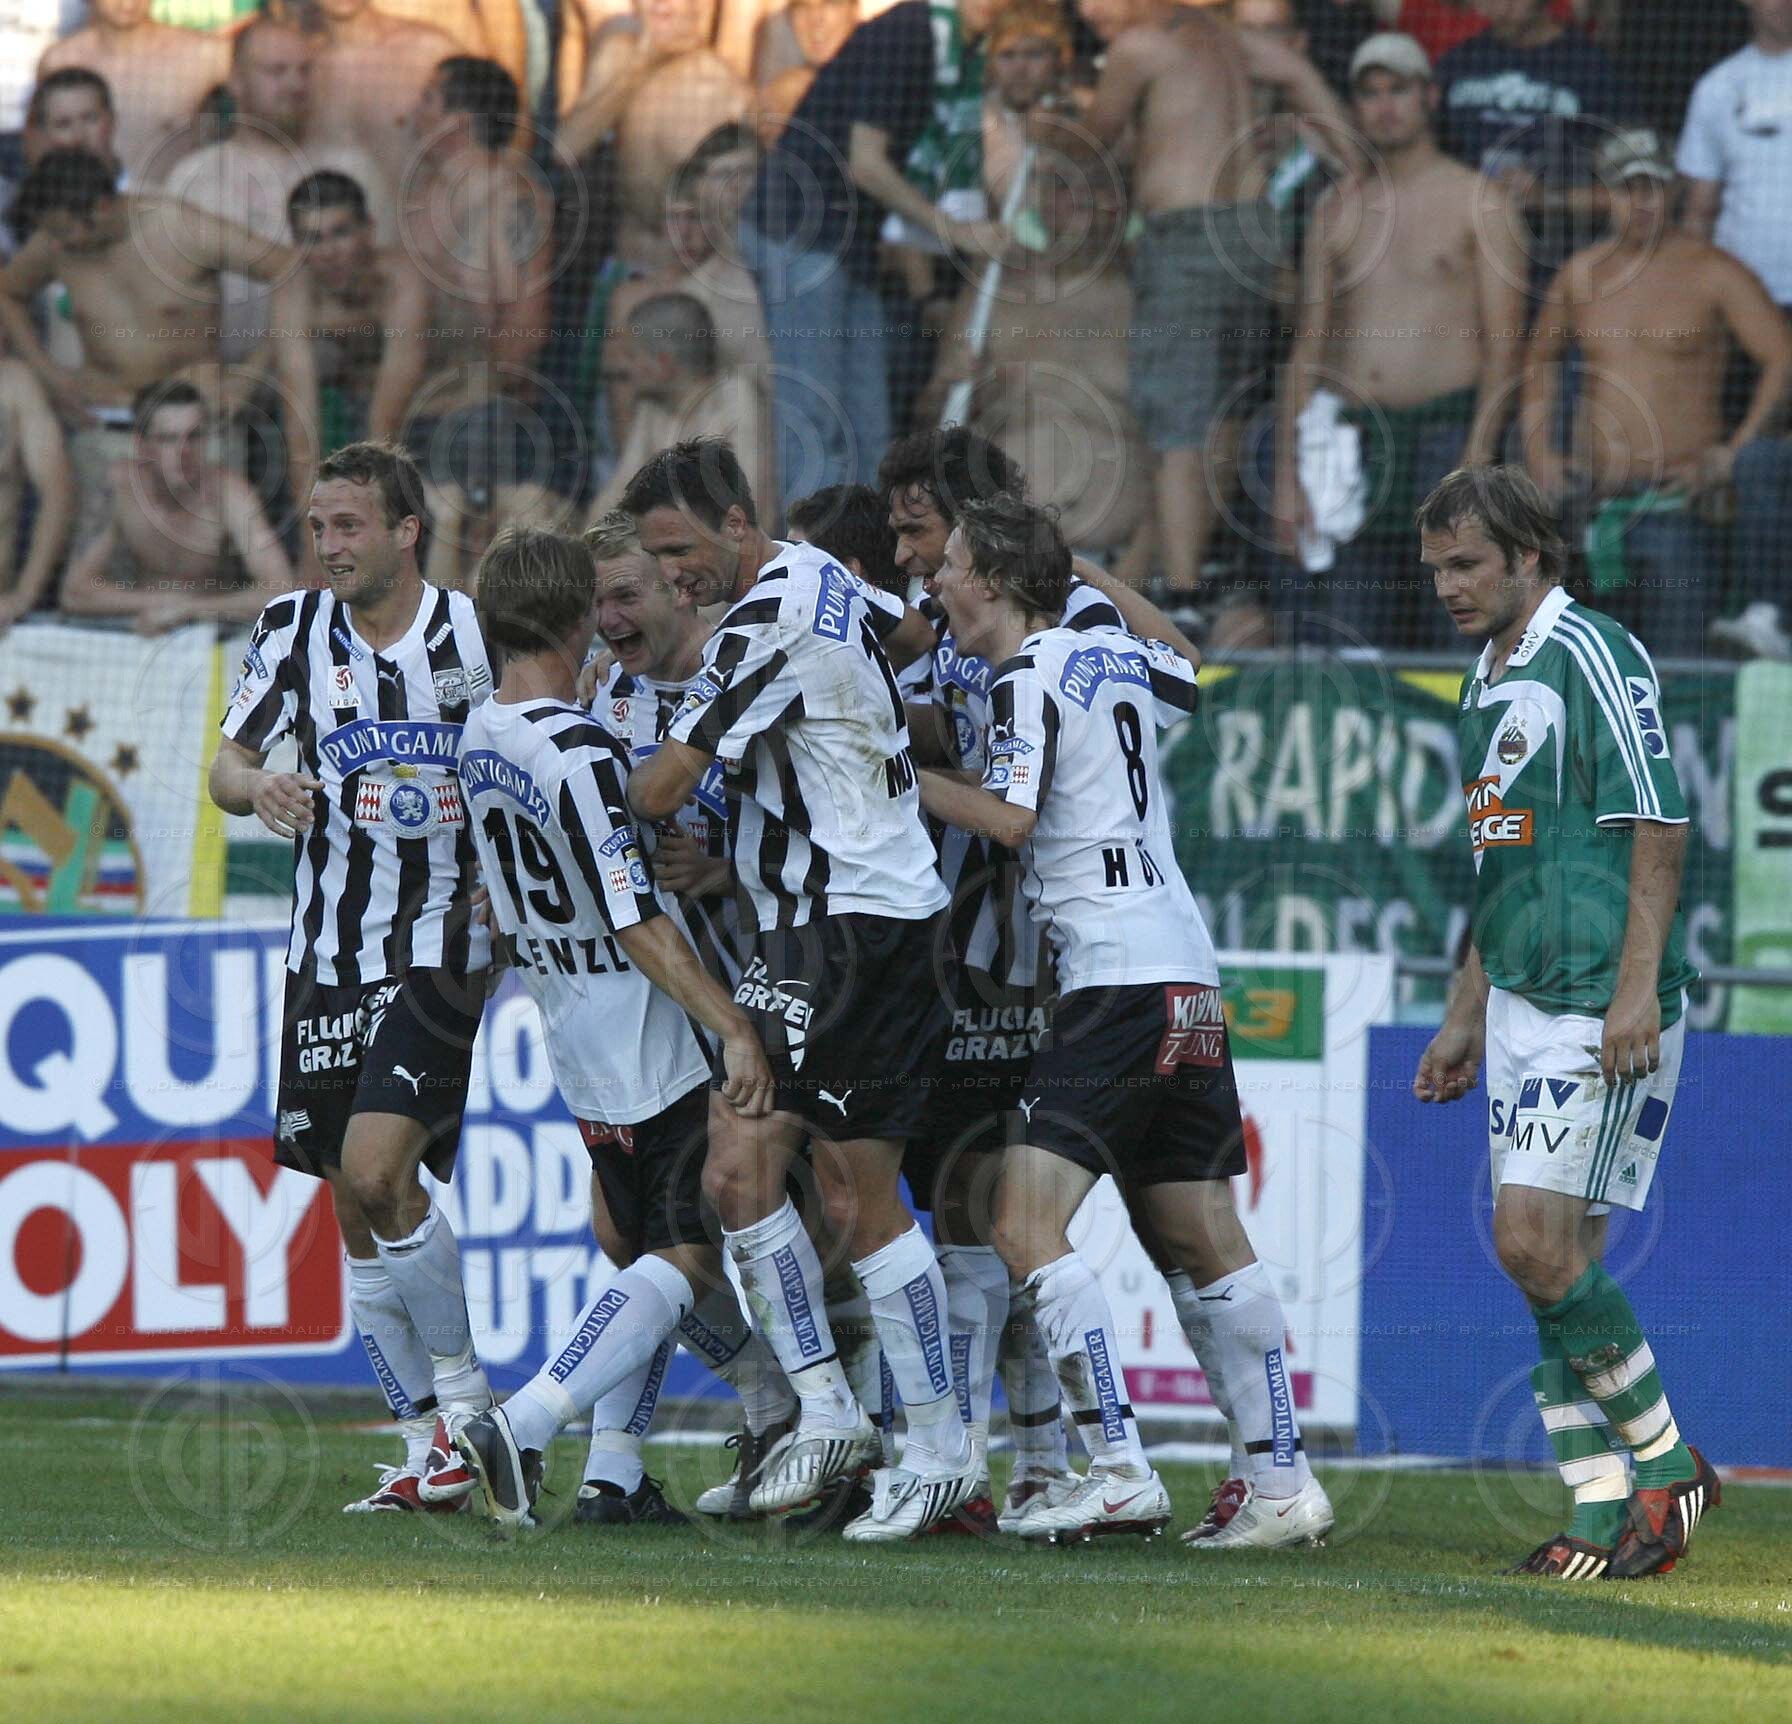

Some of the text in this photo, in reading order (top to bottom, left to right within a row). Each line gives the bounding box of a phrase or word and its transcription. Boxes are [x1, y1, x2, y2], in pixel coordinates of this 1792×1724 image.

[329, 697, 359, 706] LIGA
[1113, 701, 1149, 822] 8
[1211, 702, 1467, 847] RAPID
[482, 807, 576, 925] 19
[0, 1160, 325, 1343] OLY
[1088, 1333, 1125, 1440] PUNTIGAMER
[1266, 1352, 1293, 1464] PUNTIGAMER
